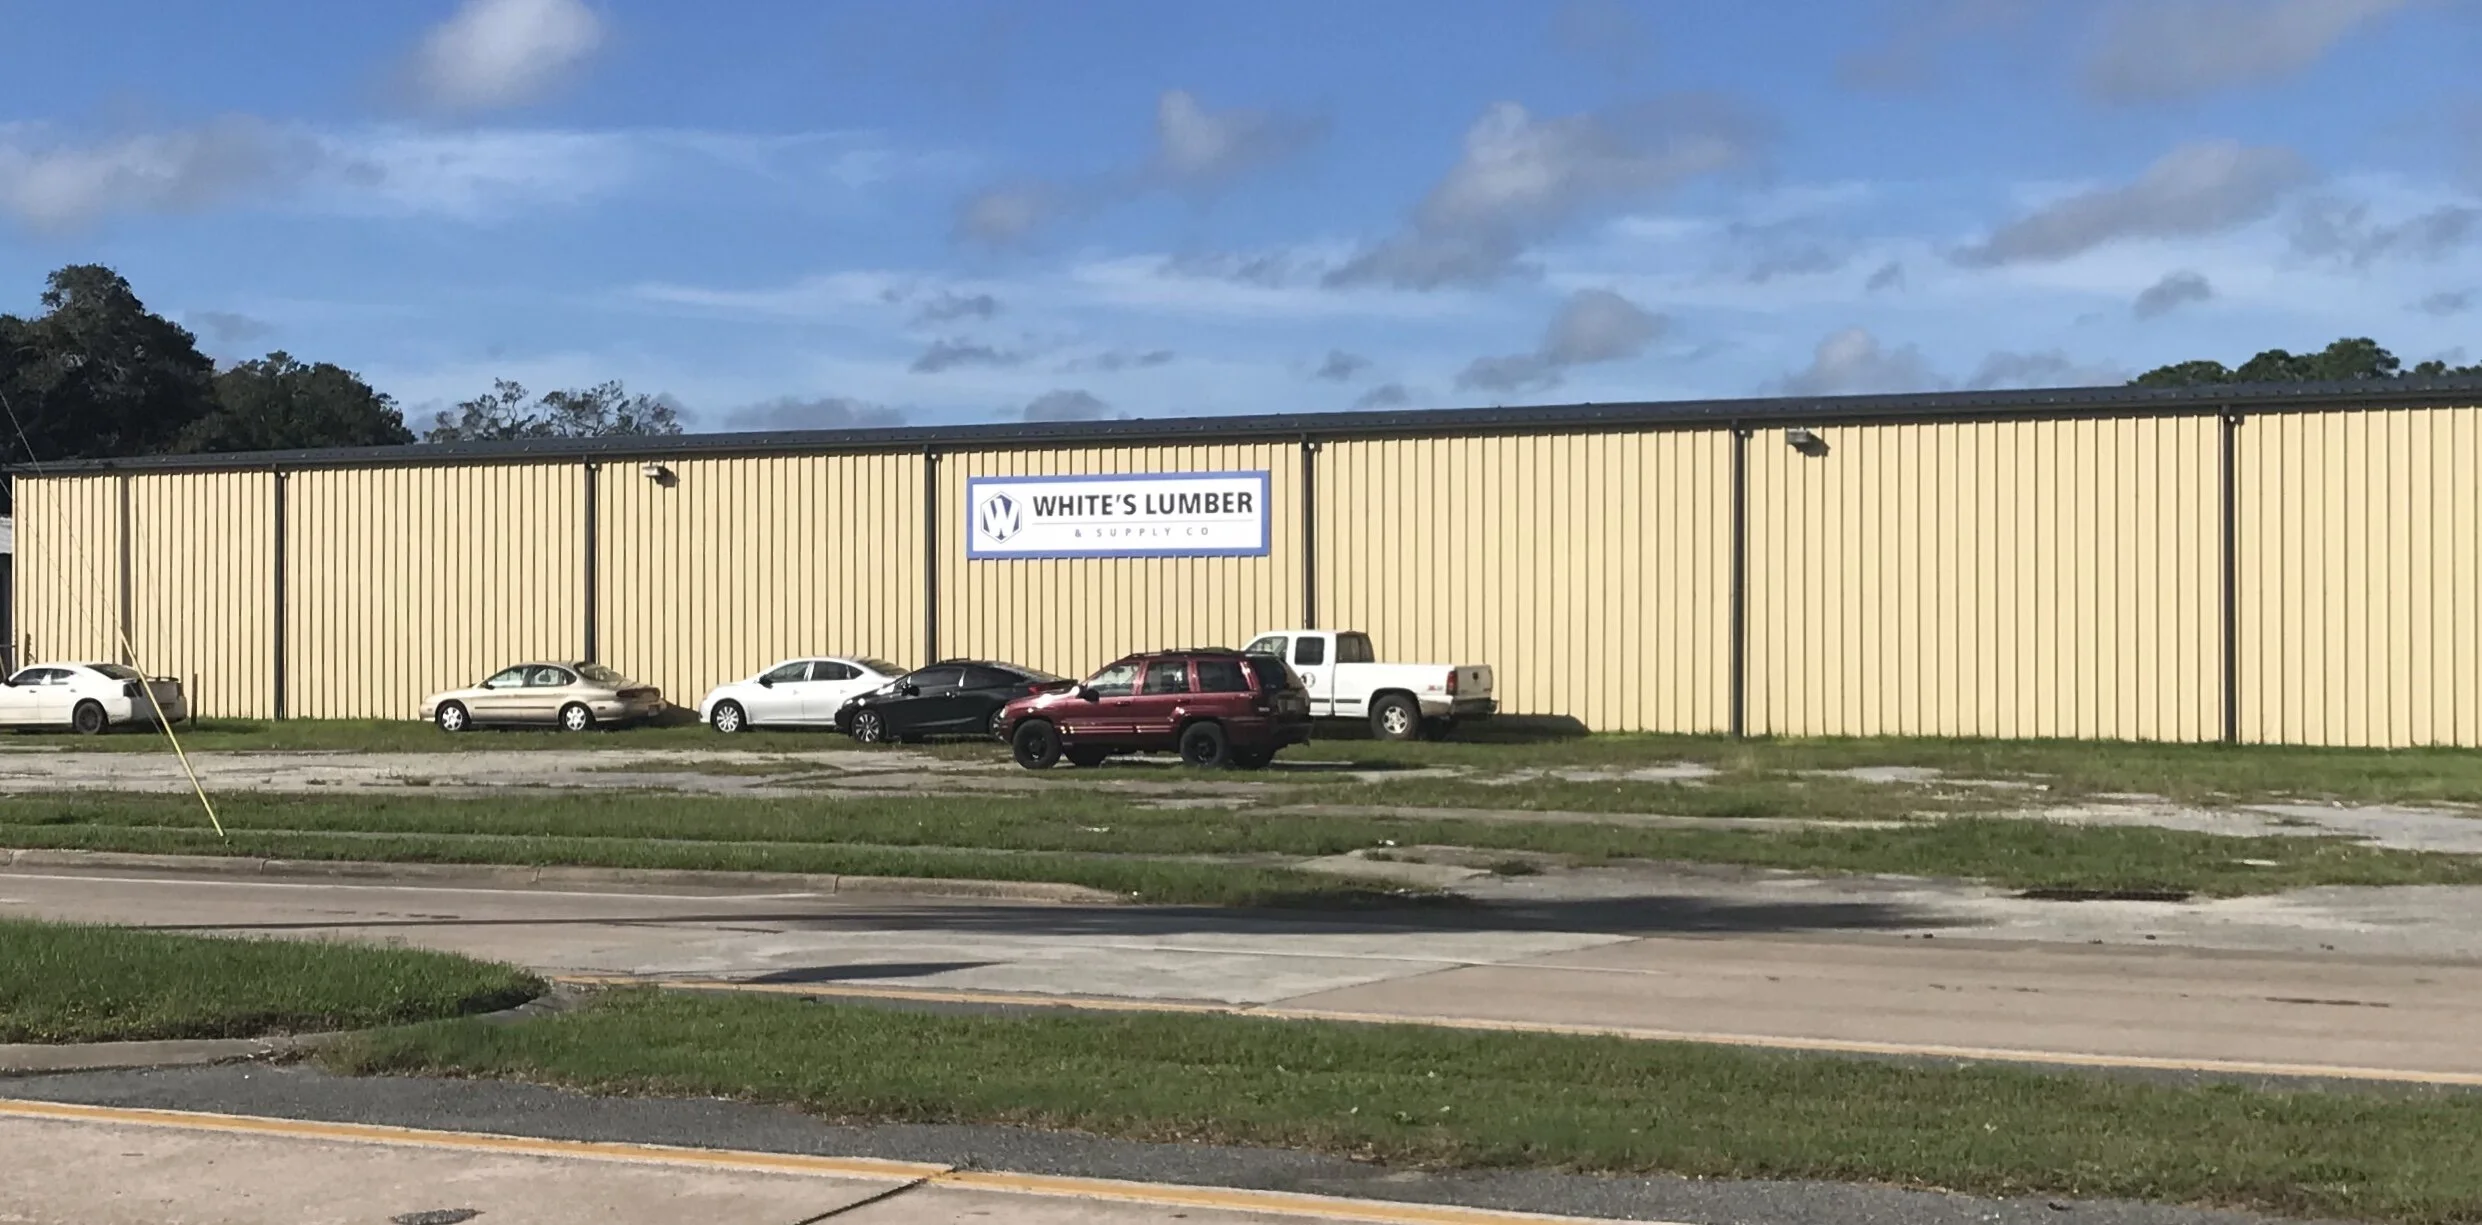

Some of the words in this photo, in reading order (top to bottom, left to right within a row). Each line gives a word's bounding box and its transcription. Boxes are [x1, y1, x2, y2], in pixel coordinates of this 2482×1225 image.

[1033, 493, 1137, 517] WHITE'S
[1146, 491, 1253, 515] LUMBER
[1074, 528, 1082, 538] &
[1096, 527, 1171, 537] SUPPLY
[1186, 526, 1209, 536] CO
